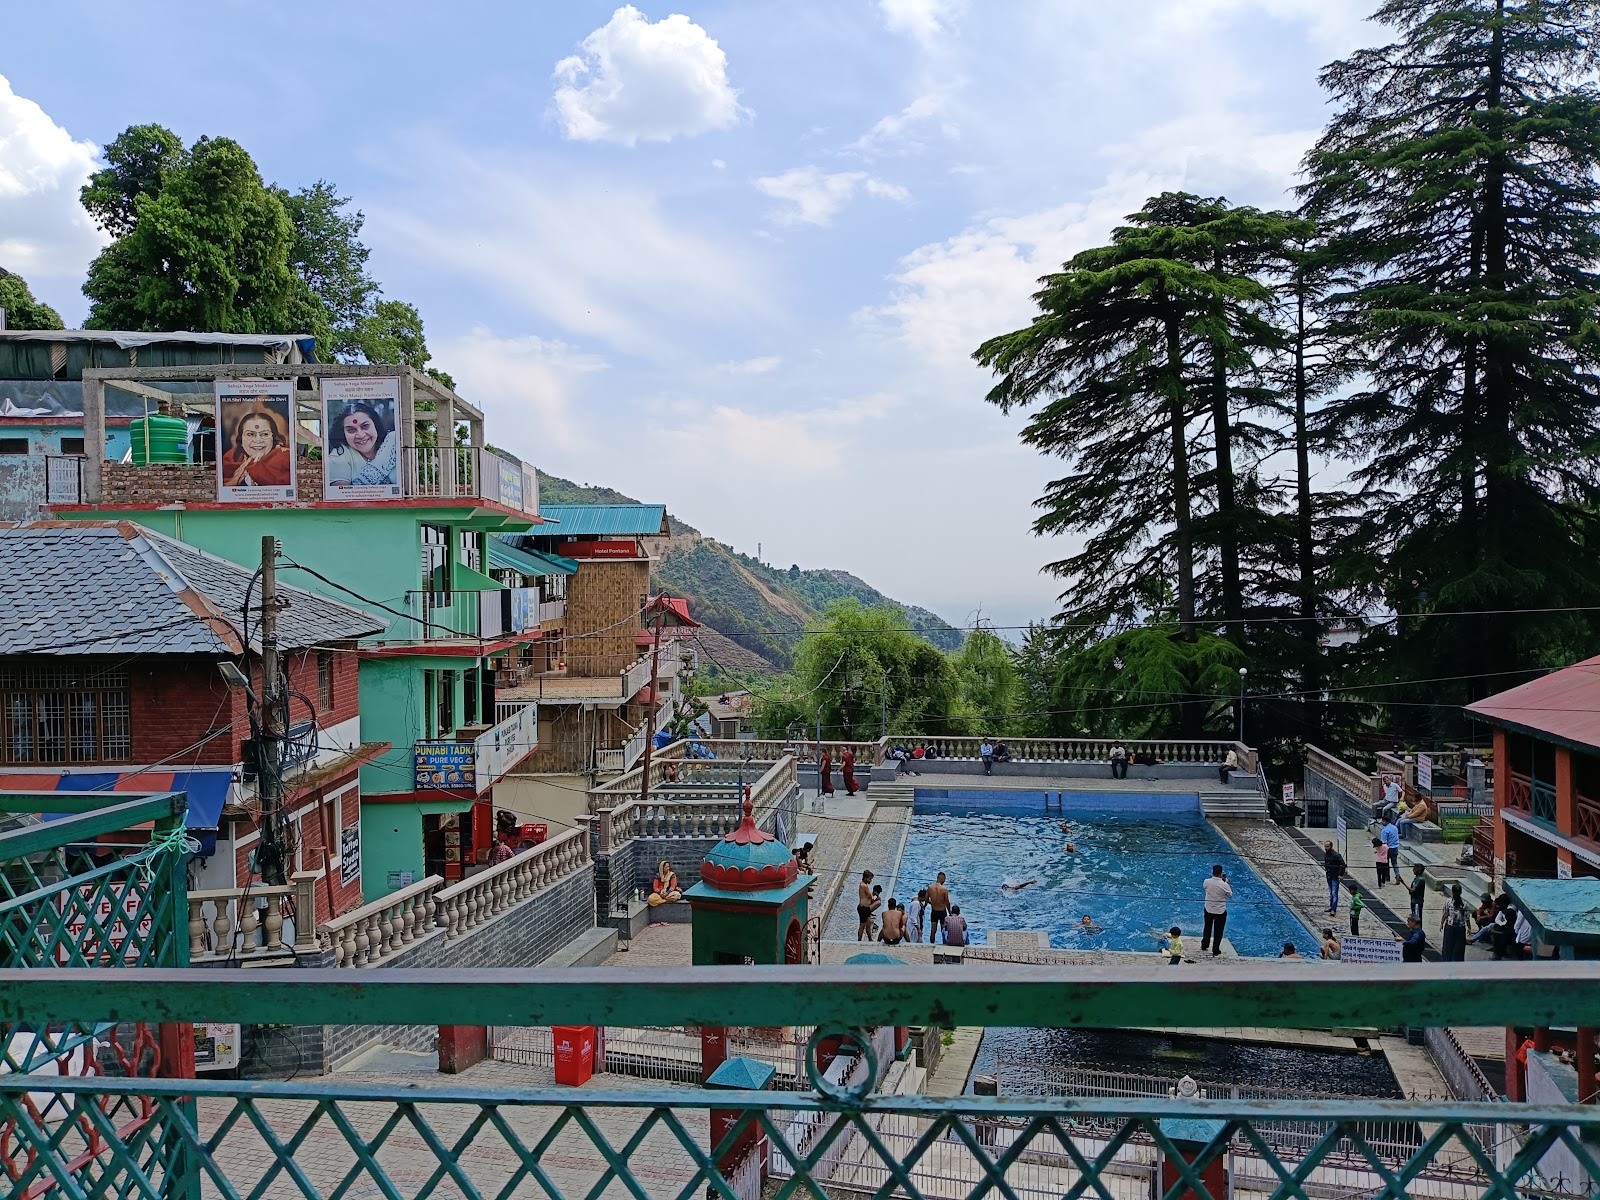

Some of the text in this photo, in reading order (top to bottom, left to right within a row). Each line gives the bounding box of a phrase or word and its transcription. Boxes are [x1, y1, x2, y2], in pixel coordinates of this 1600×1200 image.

[415, 746, 475, 756] PUNJABI TADKA
[343, 838, 358, 855] Tattoo
[343, 850, 358, 869] Studio
